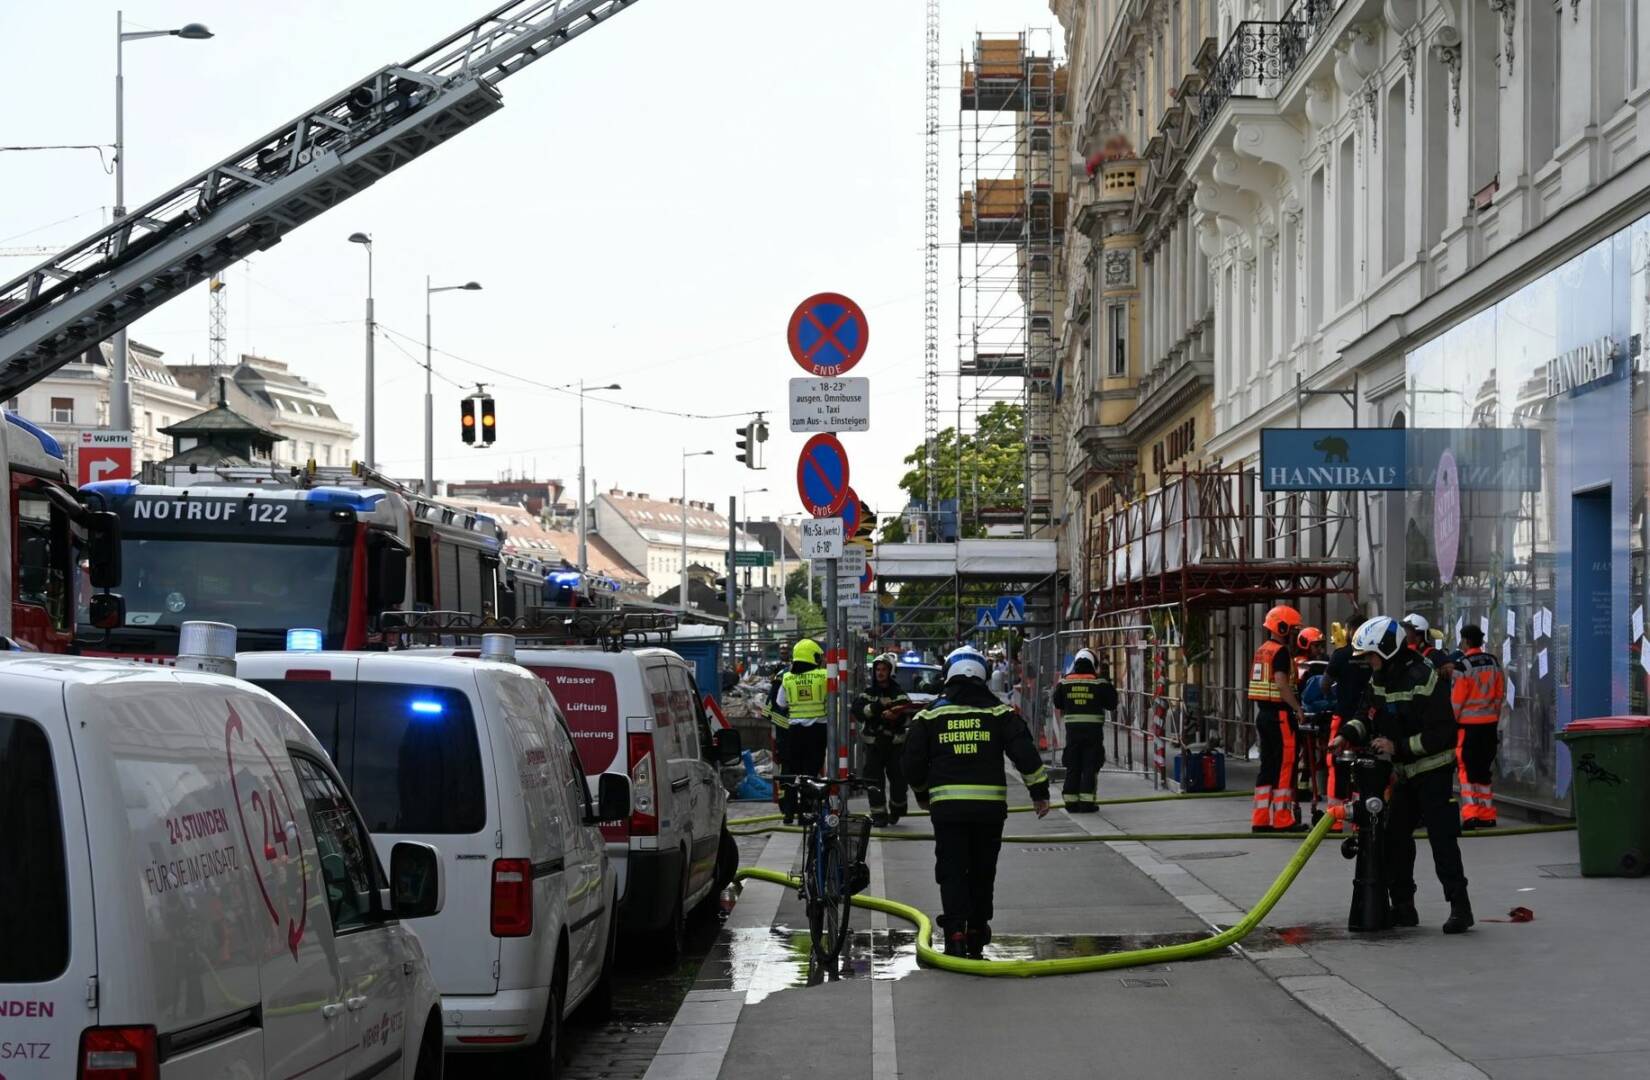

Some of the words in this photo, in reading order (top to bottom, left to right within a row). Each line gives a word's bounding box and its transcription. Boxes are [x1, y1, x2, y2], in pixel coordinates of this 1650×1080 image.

[813, 364, 843, 375] ENDE
[796, 395, 821, 404] ausgen.
[824, 394, 862, 402] Omnibusse
[826, 405, 840, 414] Taxi
[792, 418, 805, 426] zum
[806, 417, 822, 425] Aus-
[830, 416, 867, 426] Einsteigen
[134, 500, 237, 520] NOTRUF
[248, 503, 288, 523] 122
[812, 504, 833, 517] ENDE
[556, 675, 596, 684] Wasser
[567, 702, 607, 713] Lüftung
[947, 719, 981, 729] BERUFS
[939, 731, 990, 744] FEUERWEHR
[953, 743, 978, 754] WIEN
[166, 818, 183, 845] 24
[182, 807, 229, 840] STUNDEN
[251, 790, 288, 861] 24
[145, 860, 171, 895] FÜR
[169, 859, 188, 889] SIE
[188, 855, 199, 881] IM
[201, 846, 239, 879] EINSATZ
